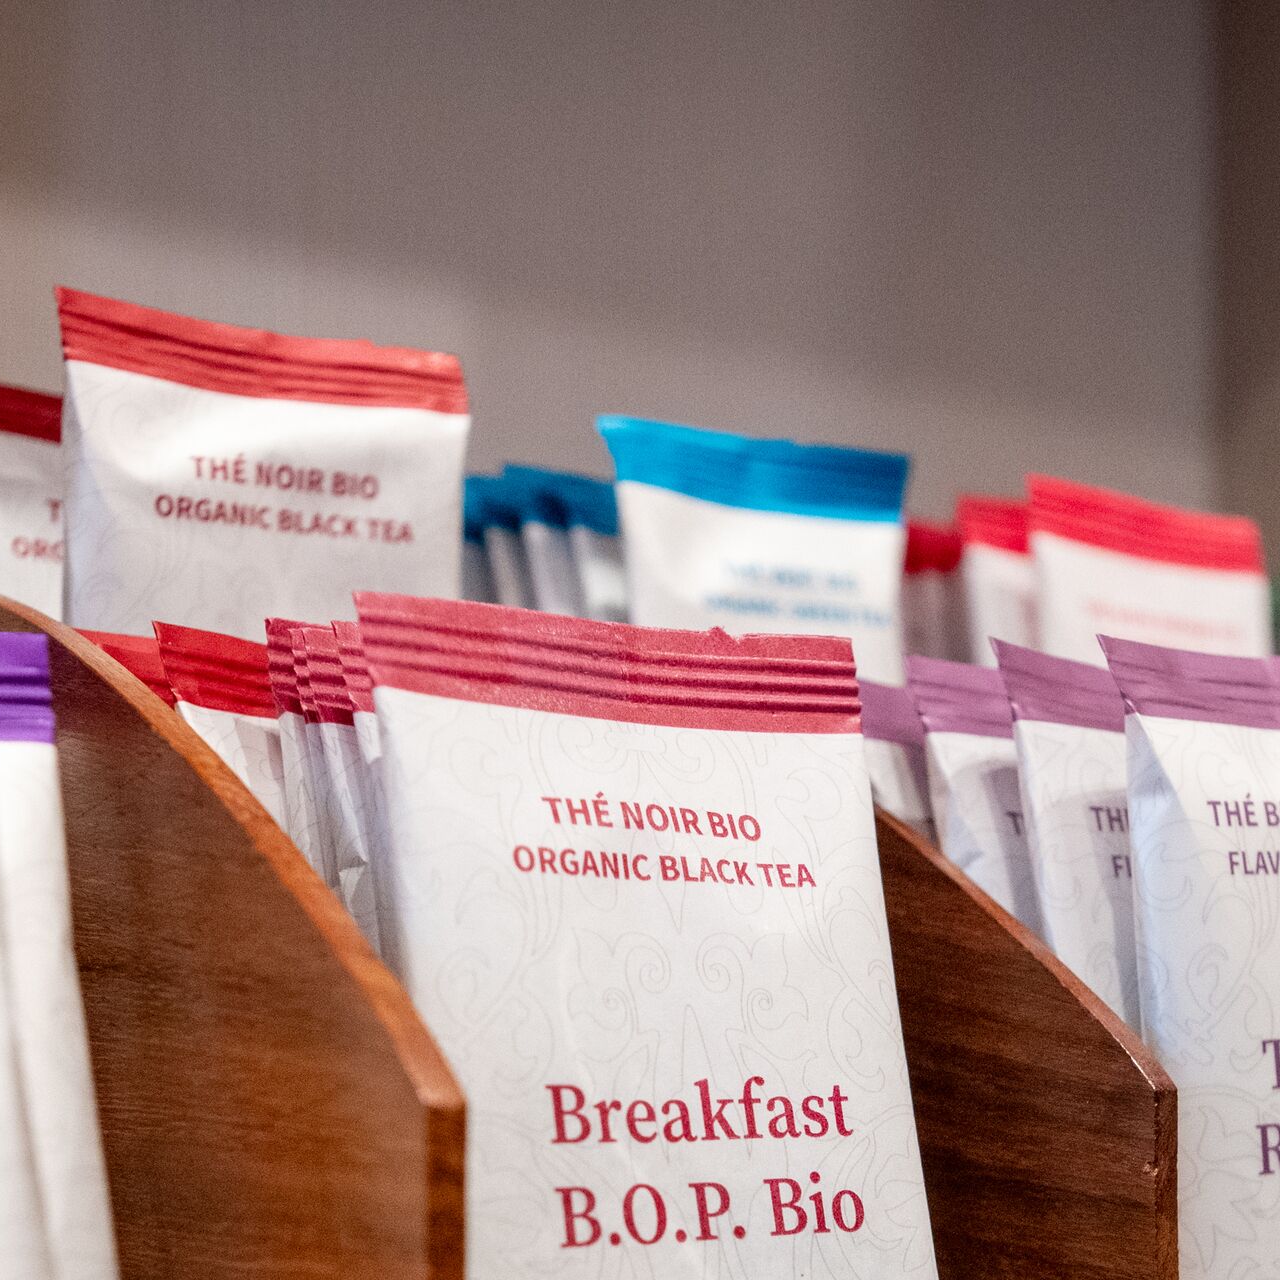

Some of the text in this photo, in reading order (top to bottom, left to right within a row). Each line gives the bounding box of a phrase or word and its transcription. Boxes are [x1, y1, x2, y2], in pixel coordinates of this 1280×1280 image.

[190, 453, 380, 500] THÉ NOIR BIO
[154, 494, 414, 544] ORGANIC BLACK TEA
[541, 791, 761, 842] THÉ NOIR BIO
[1089, 805, 1129, 832] TH
[1207, 793, 1259, 828] THÉ
[512, 845, 817, 888] ORGANIC BLACK TEA
[545, 1076, 854, 1144] Breakfast
[554, 1171, 865, 1248] B.O.P. Bio
